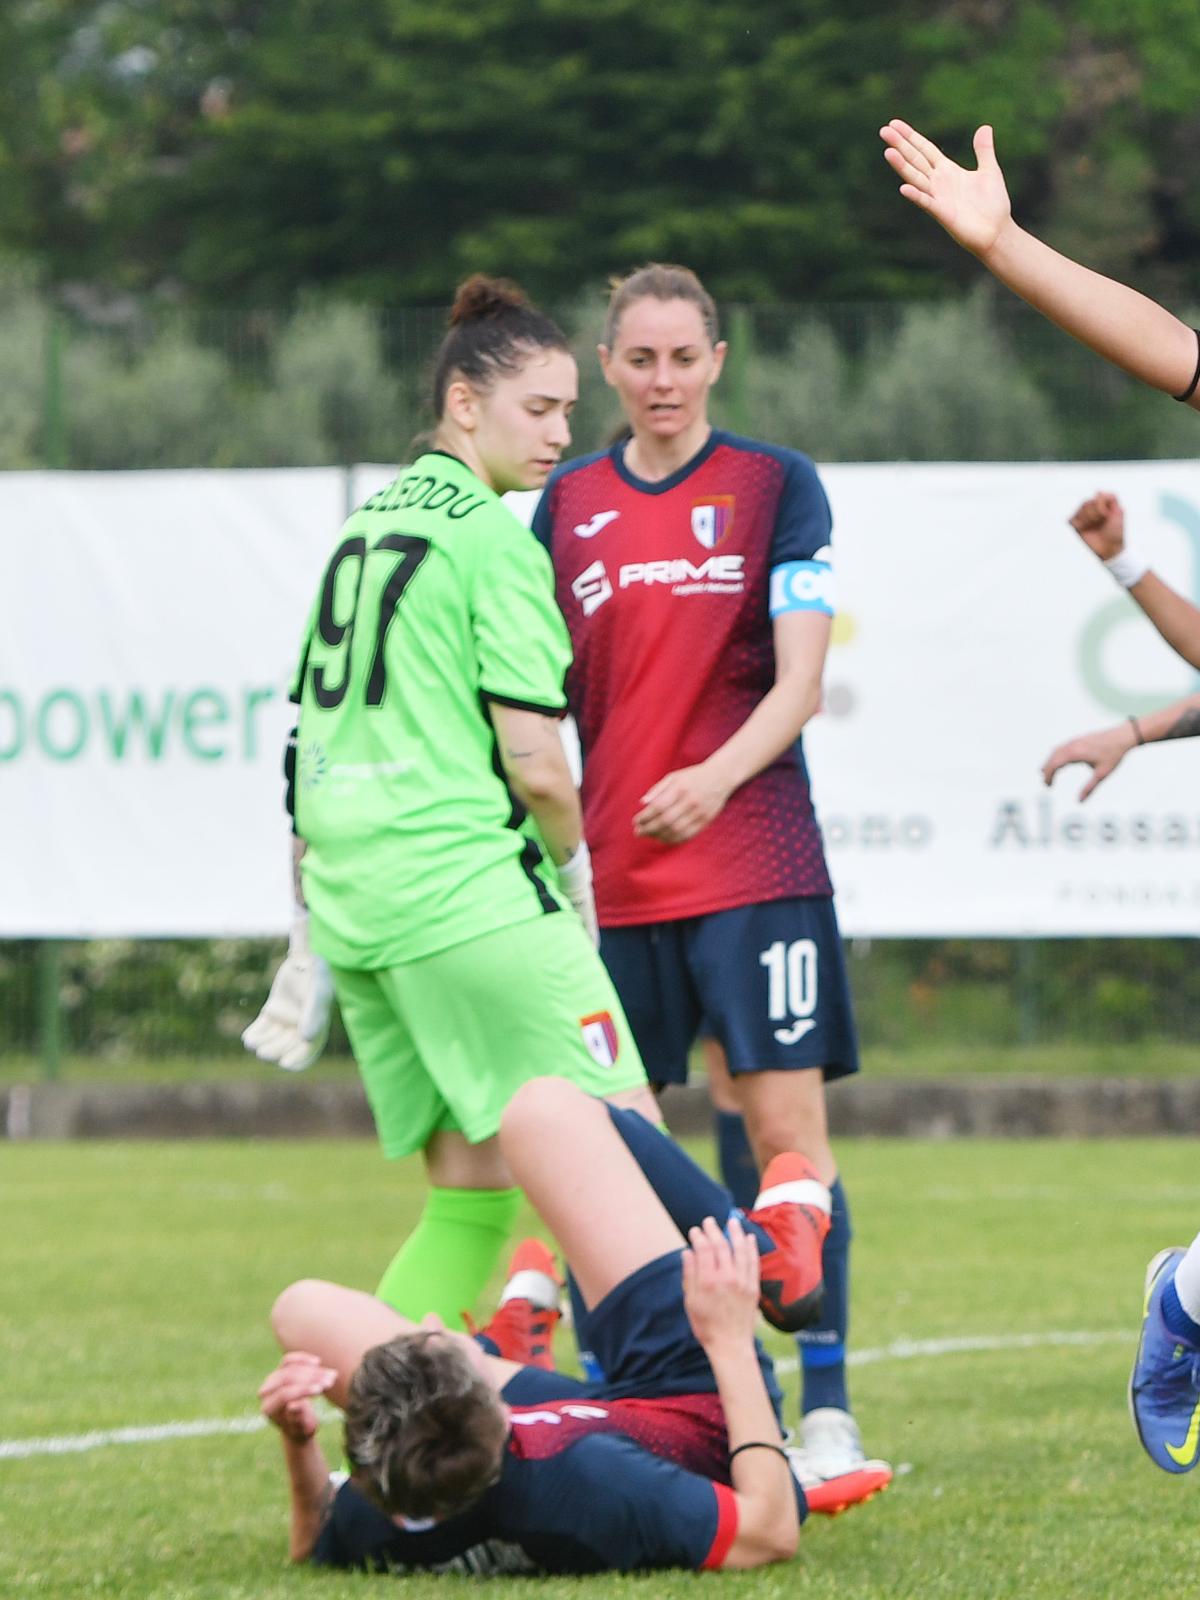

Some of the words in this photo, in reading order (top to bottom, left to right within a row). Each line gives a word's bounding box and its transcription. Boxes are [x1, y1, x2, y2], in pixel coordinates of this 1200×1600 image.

[618, 555, 745, 589] PRIME
[309, 533, 432, 710] 97
[825, 813, 934, 851] ono
[759, 938, 818, 1021] 10
